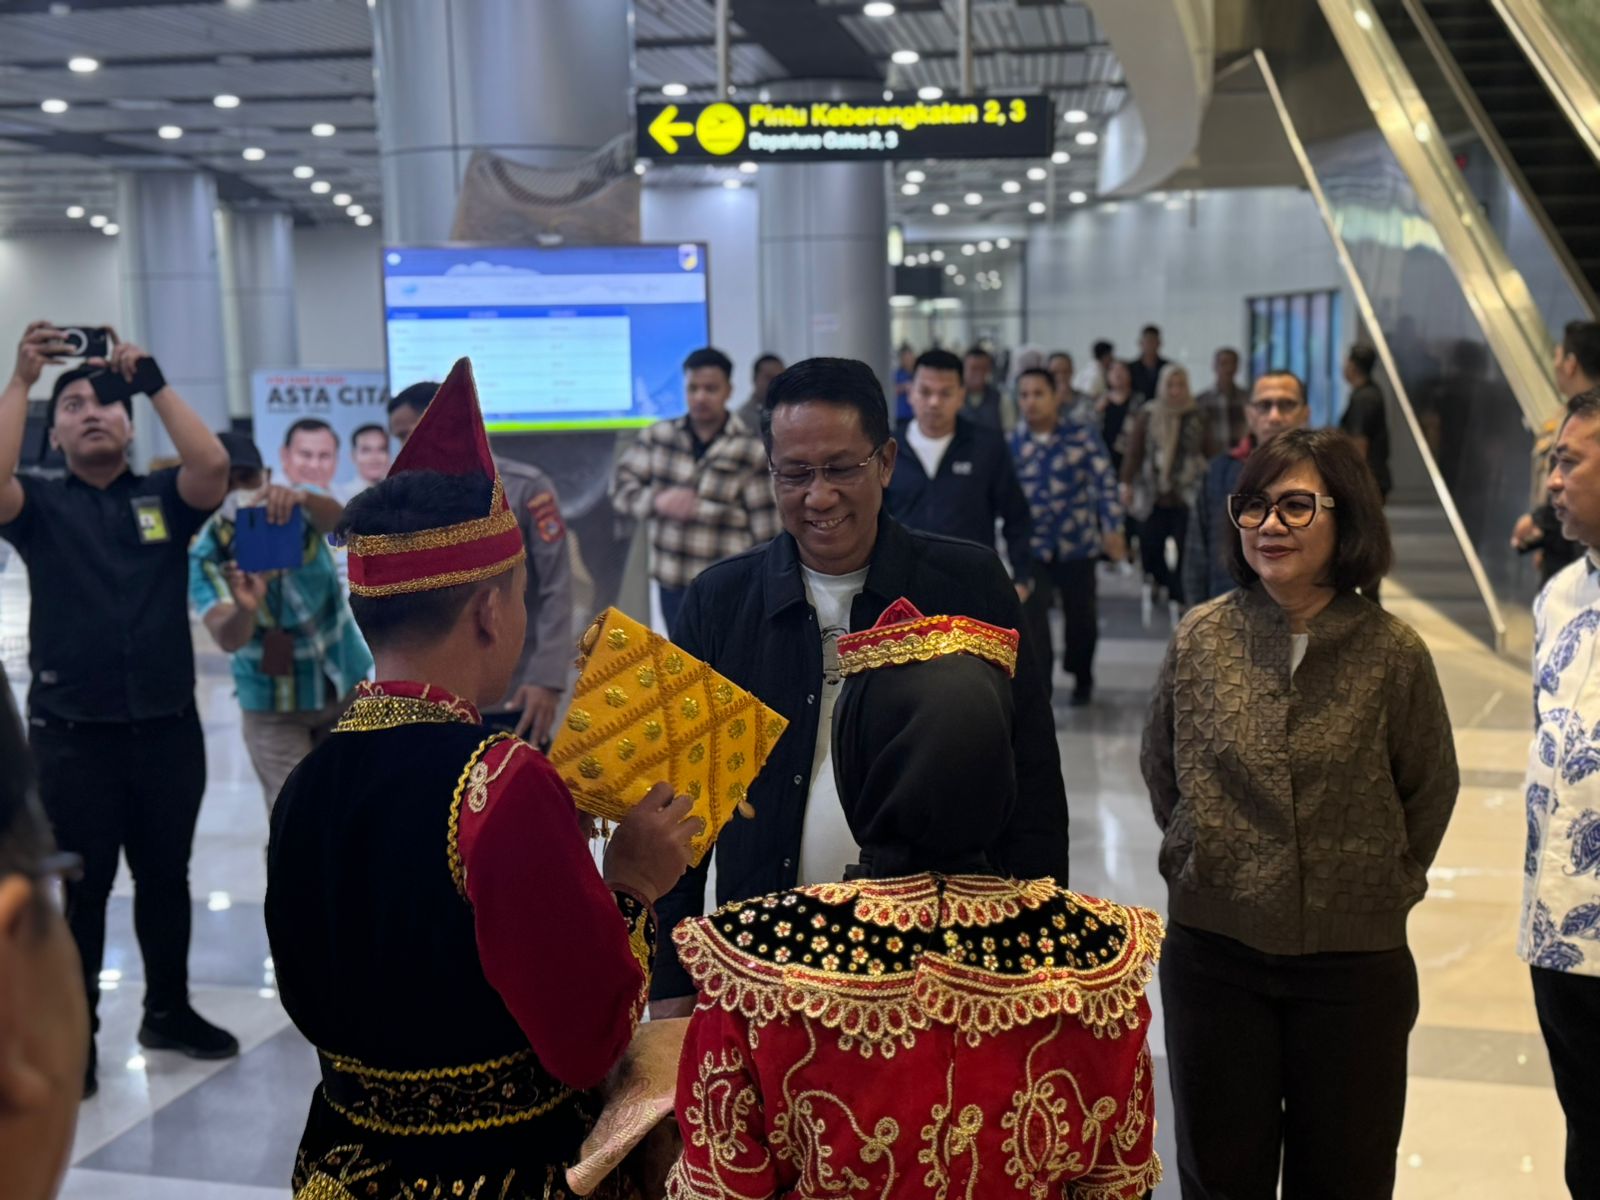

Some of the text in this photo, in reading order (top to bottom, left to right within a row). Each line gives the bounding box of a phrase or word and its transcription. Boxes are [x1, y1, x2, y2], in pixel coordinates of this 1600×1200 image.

[749, 103, 807, 127] Pintu
[811, 101, 978, 130] Keberangkatan
[1009, 98, 1026, 122] 3
[748, 131, 822, 152] Departure
[823, 131, 868, 149] Gates
[268, 386, 331, 405] ASTA
